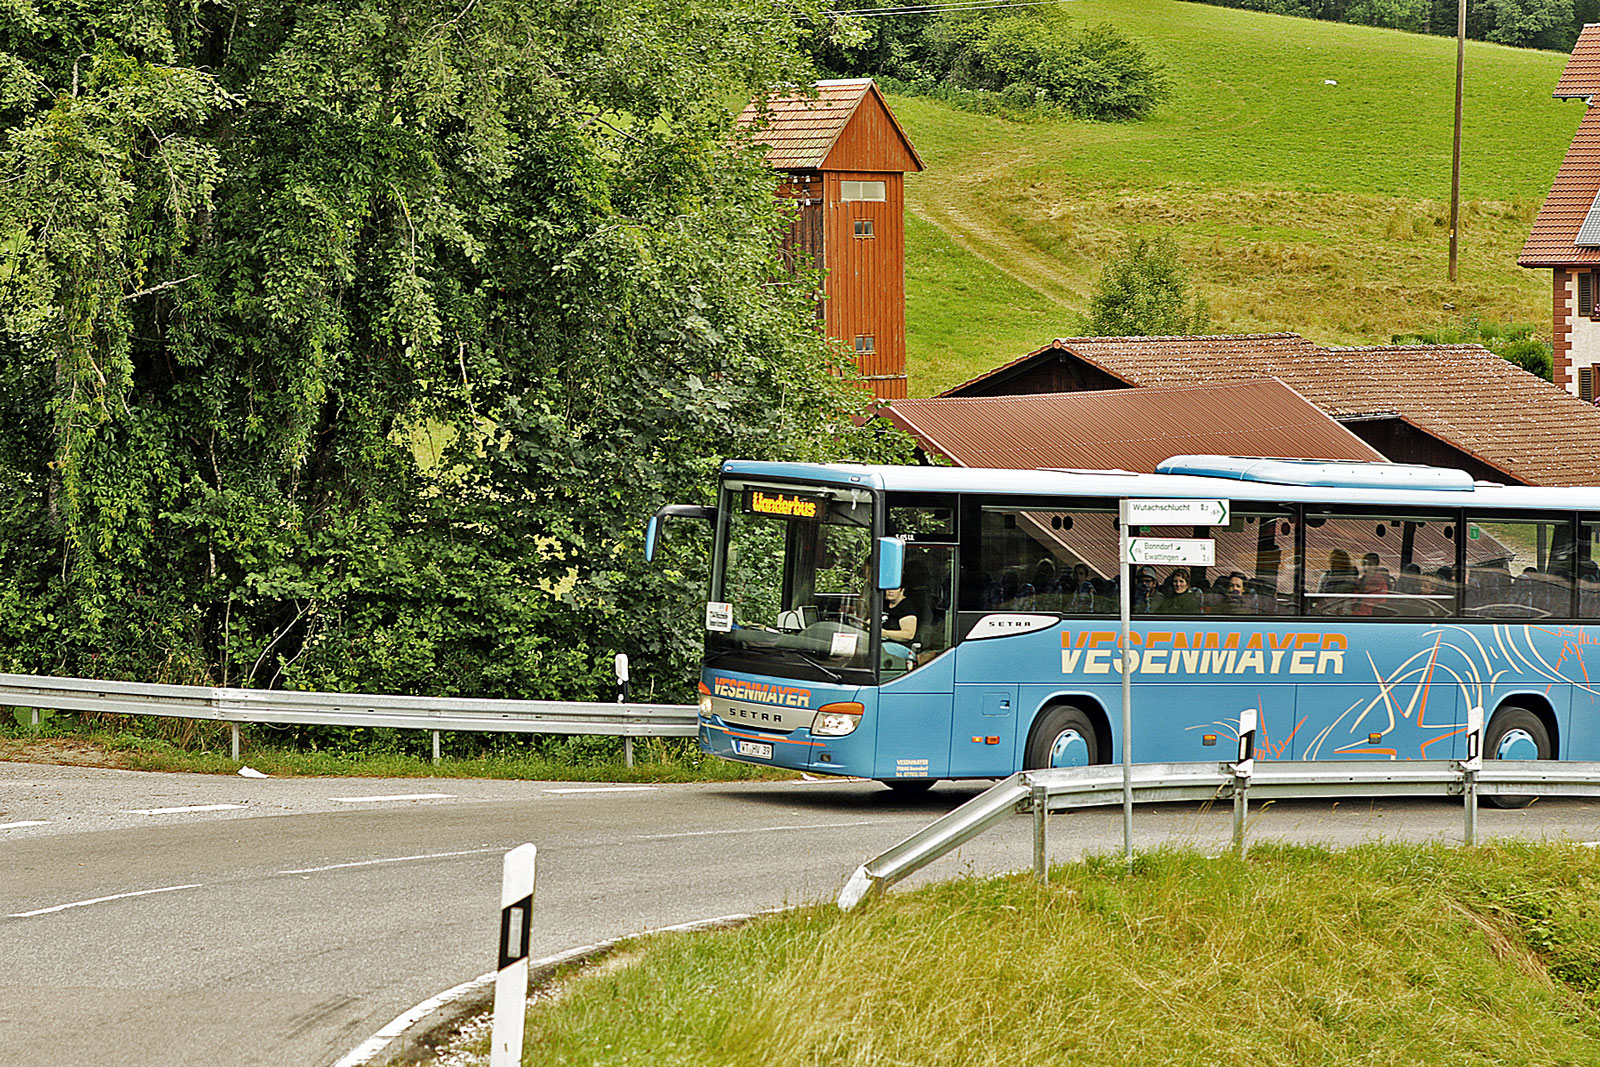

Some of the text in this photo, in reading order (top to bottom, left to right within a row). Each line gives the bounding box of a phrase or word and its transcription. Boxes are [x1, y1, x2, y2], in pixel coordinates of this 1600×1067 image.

[1132, 503, 1190, 511] Wutachschlucht
[1144, 542, 1173, 550] Bonndorf
[1144, 552, 1179, 562] Ewattingen
[1060, 631, 1348, 674] VESENMAYER
[714, 676, 811, 707] VESENMAYER
[729, 708, 782, 722] SETRA
